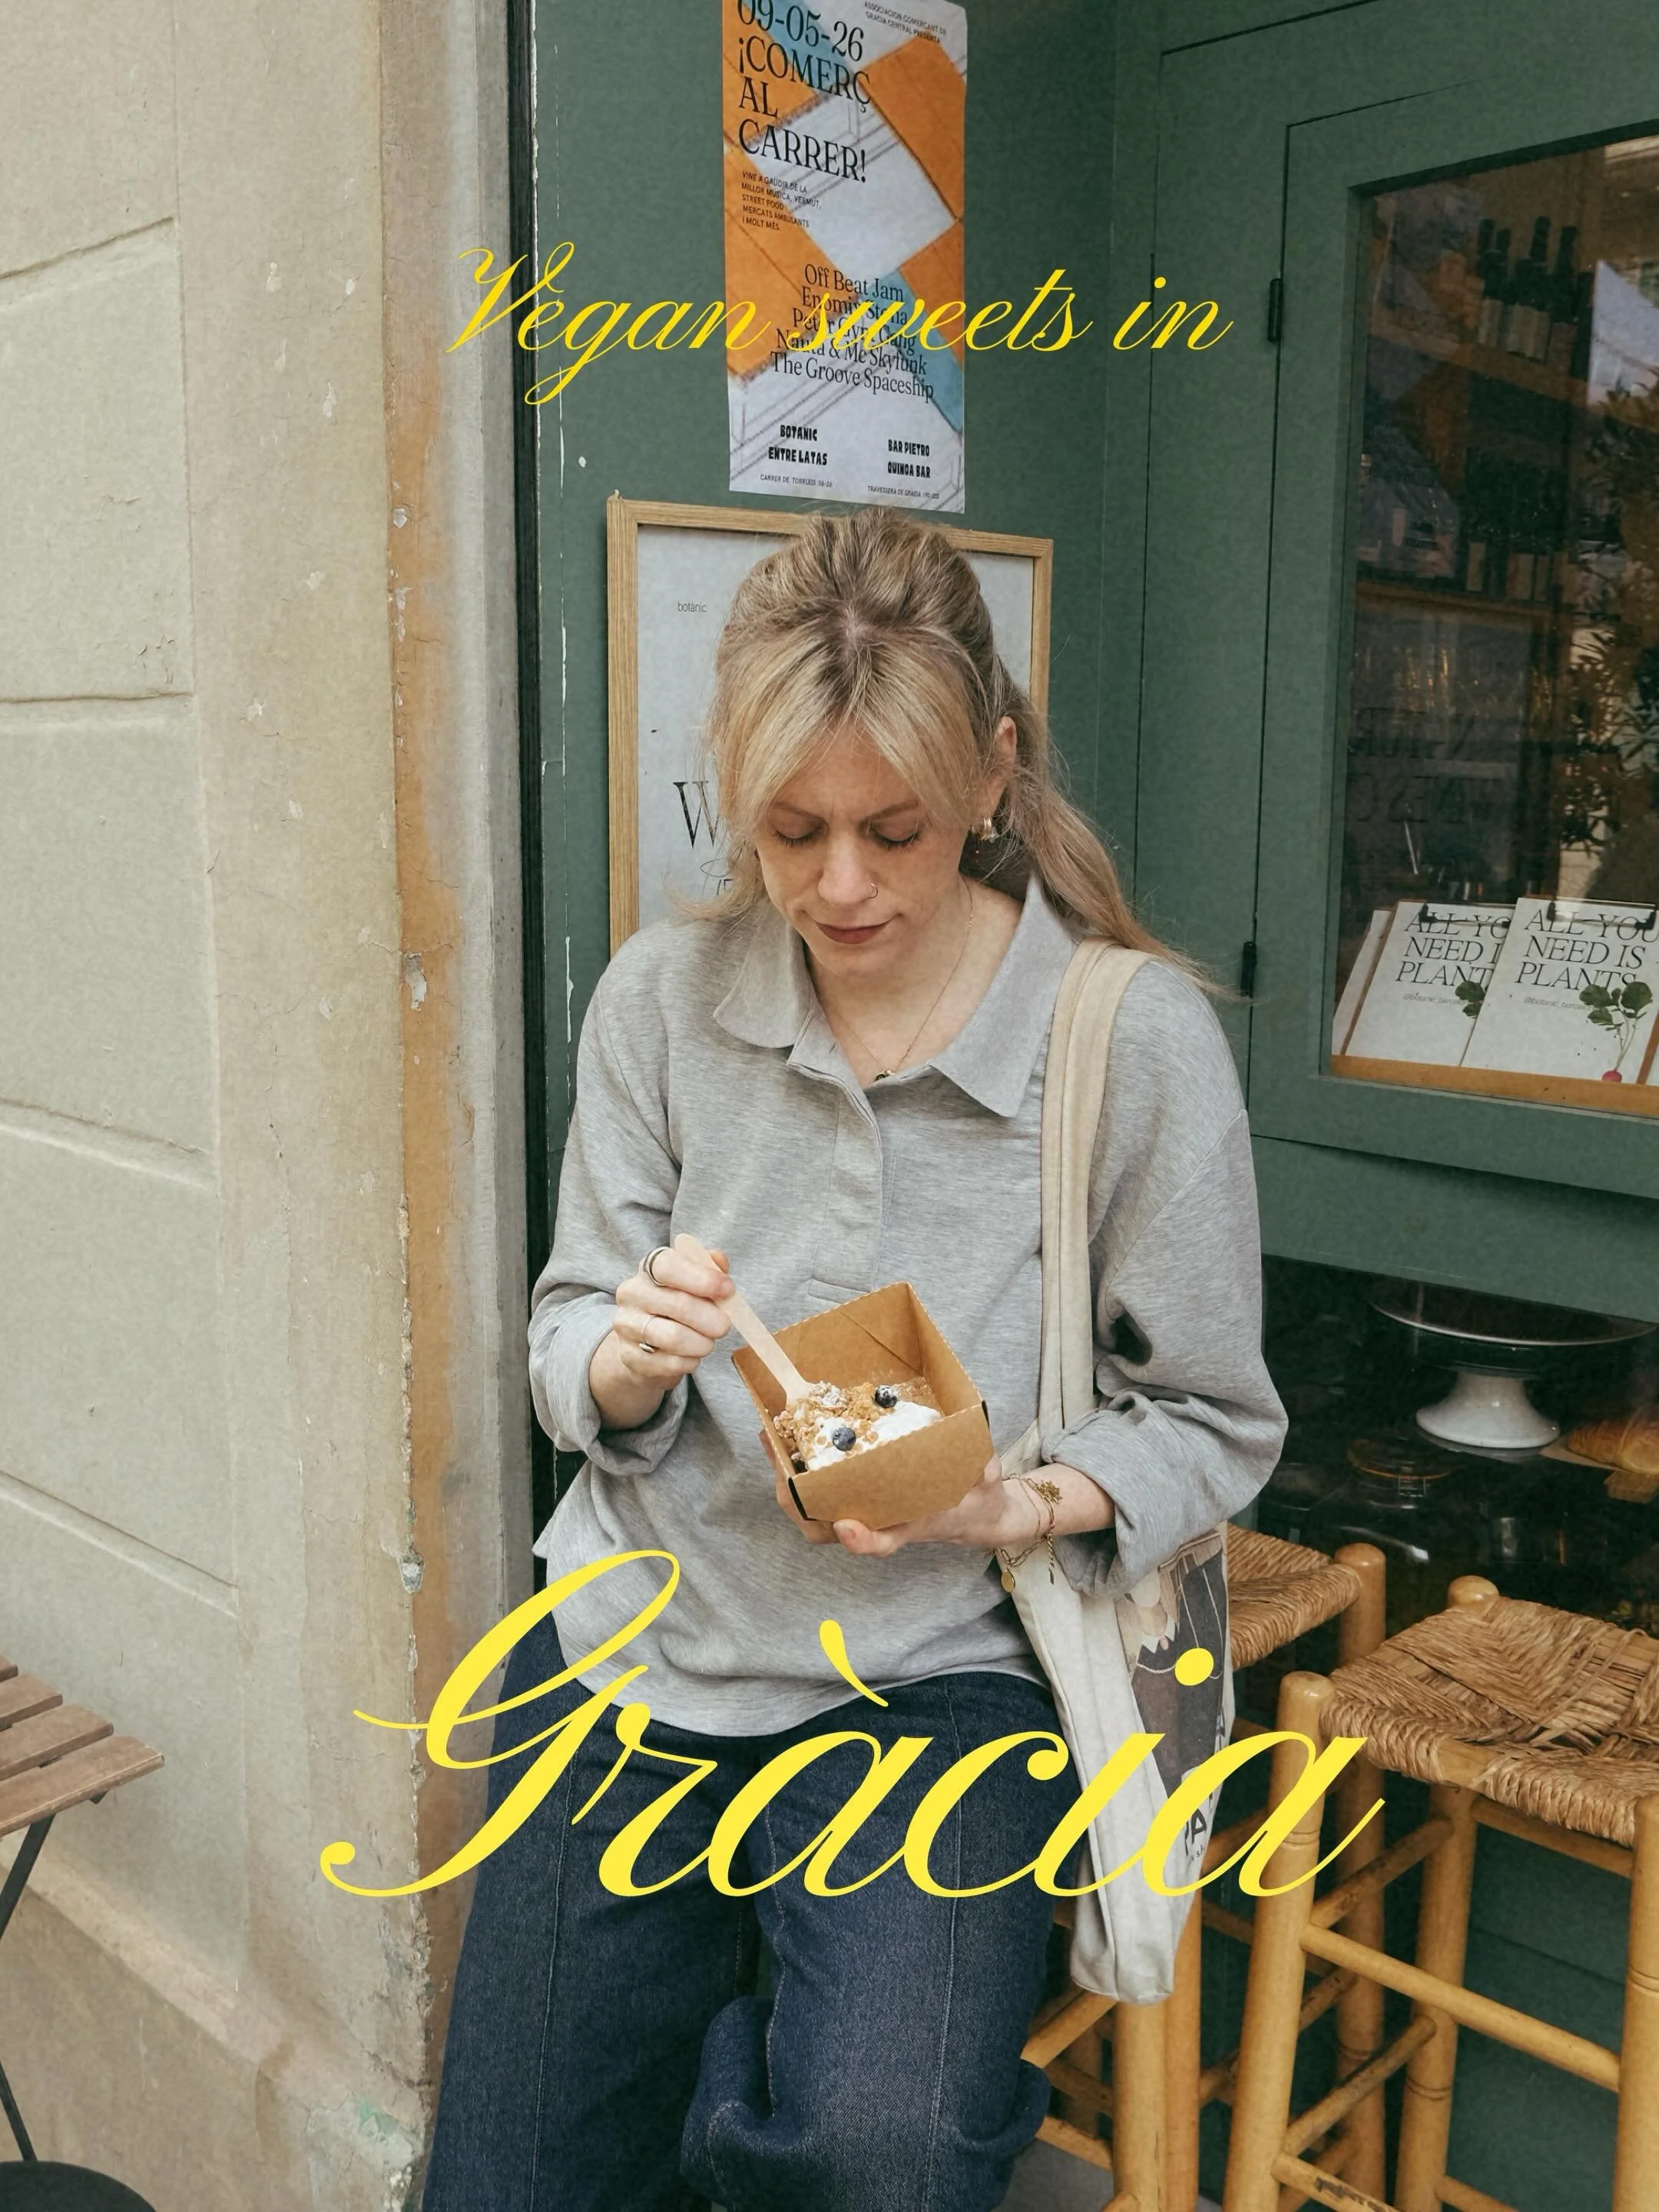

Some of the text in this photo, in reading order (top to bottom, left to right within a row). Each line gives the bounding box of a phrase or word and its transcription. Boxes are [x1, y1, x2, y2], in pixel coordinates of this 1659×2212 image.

[738, 0, 864, 61] 09-05-26
[739, 35, 872, 114] ¡COMERÇ
[739, 76, 778, 118] AL
[738, 118, 866, 184] CARRER!
[741, 182, 765, 194] MILLOR
[742, 171, 757, 181] VINE
[764, 177, 790, 189] GAUDIR
[790, 181, 798, 191] DE
[800, 185, 807, 194] LA
[742, 194, 765, 206] STREET
[743, 205, 810, 228] MERCATS AMBULANTS
[746, 217, 764, 228] MOLT
[804, 263, 904, 302] Off Beat Jam
[793, 307, 836, 335] Petr
[869, 346, 927, 375] Skyfunk
[770, 350, 934, 404] The Groove Spaceship
[780, 424, 817, 442] BOTANIC
[769, 446, 828, 466] ENTRE LATAS
[888, 439, 930, 457] BAR PIETRO
[760, 474, 781, 482] CARRER
[888, 461, 931, 478] QUINOA BAR
[867, 485, 896, 495] TRAVESSERA
[1404, 911, 1512, 939] ALL YO
[1524, 909, 1659, 943] ALL YOU
[1404, 936, 1484, 962] NEED
[1524, 935, 1646, 970] NEED IS
[1395, 961, 1495, 992] PLANT
